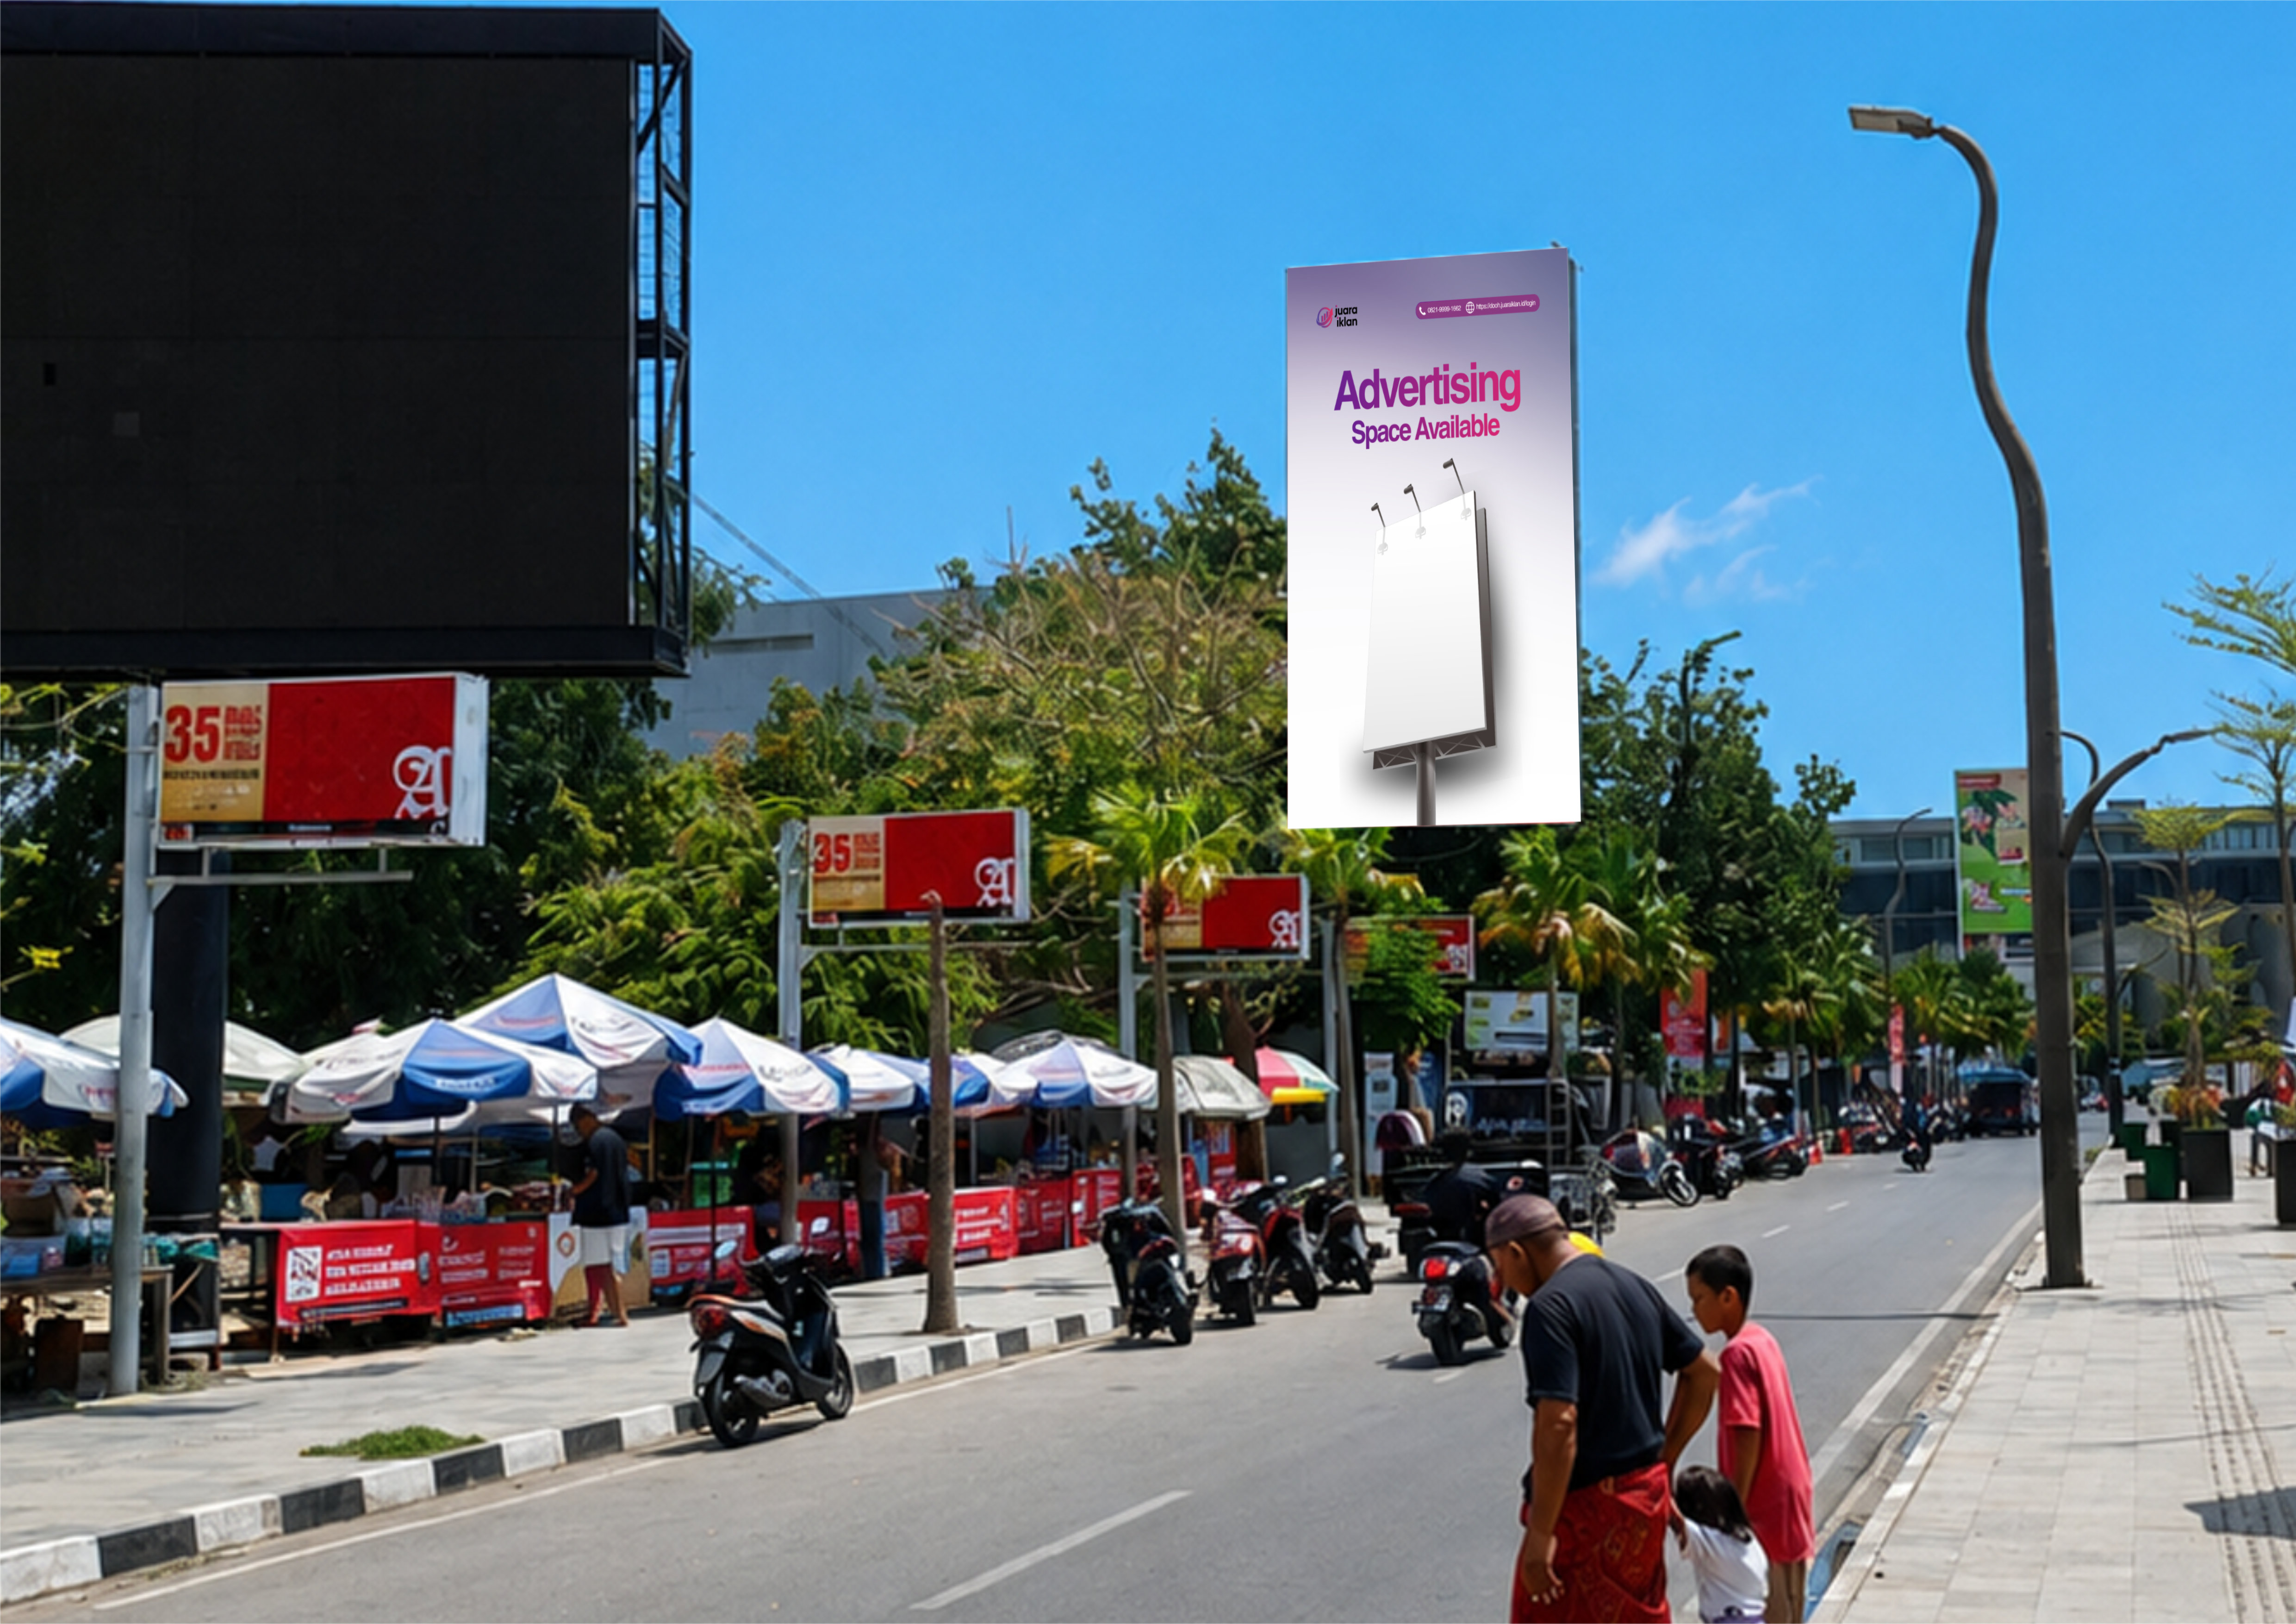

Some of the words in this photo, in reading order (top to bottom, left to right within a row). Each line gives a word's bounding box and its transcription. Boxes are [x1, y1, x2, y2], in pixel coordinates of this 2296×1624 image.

[1334, 305, 1357, 318] juara
[1337, 316, 1357, 327] iklan
[1334, 362, 1521, 412] Advertising
[1351, 419, 1411, 450] Space
[1414, 413, 1500, 440] Available
[164, 704, 220, 763] 35
[814, 831, 851, 874] 35
